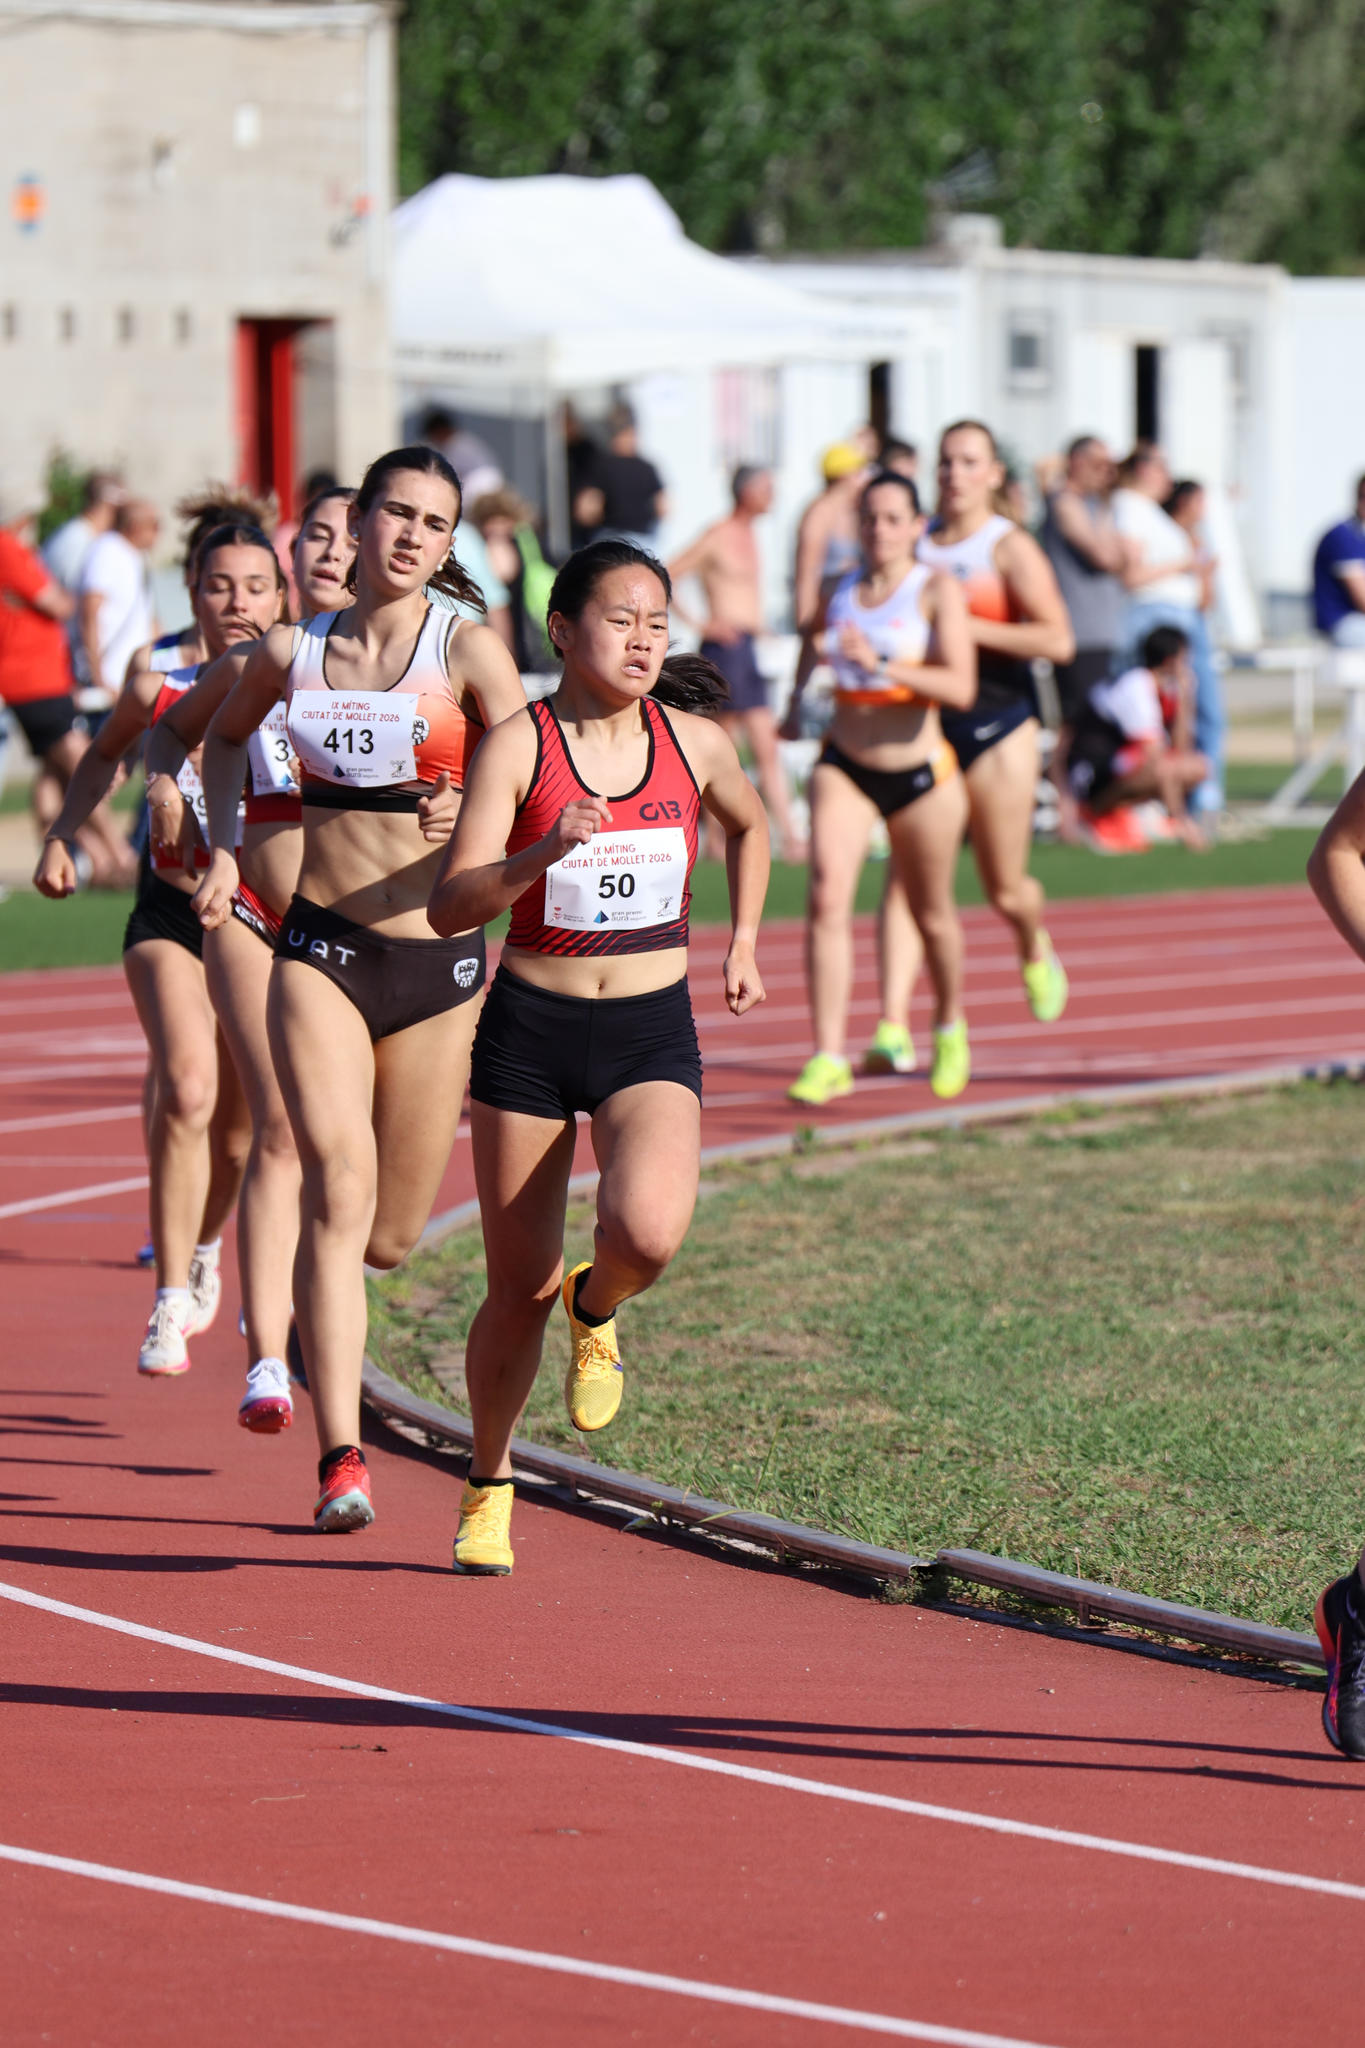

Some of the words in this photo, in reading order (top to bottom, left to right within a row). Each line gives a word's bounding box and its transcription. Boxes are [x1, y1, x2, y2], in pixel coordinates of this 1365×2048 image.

[331, 701, 339, 709] IX
[301, 710, 330, 720] CIUTAT
[332, 711, 343, 720] DE
[345, 712, 377, 722] MOLLET
[378, 713, 400, 722] 2026
[323, 727, 374, 754] 413
[593, 846, 601, 856] IX
[604, 843, 636, 855] MÍTING
[561, 858, 593, 869] CIUTAT
[597, 857, 608, 867] DE
[611, 854, 645, 866] MOLLET
[649, 852, 672, 863] 2026
[598, 873, 635, 899] 50
[288, 928, 357, 966] UAT
